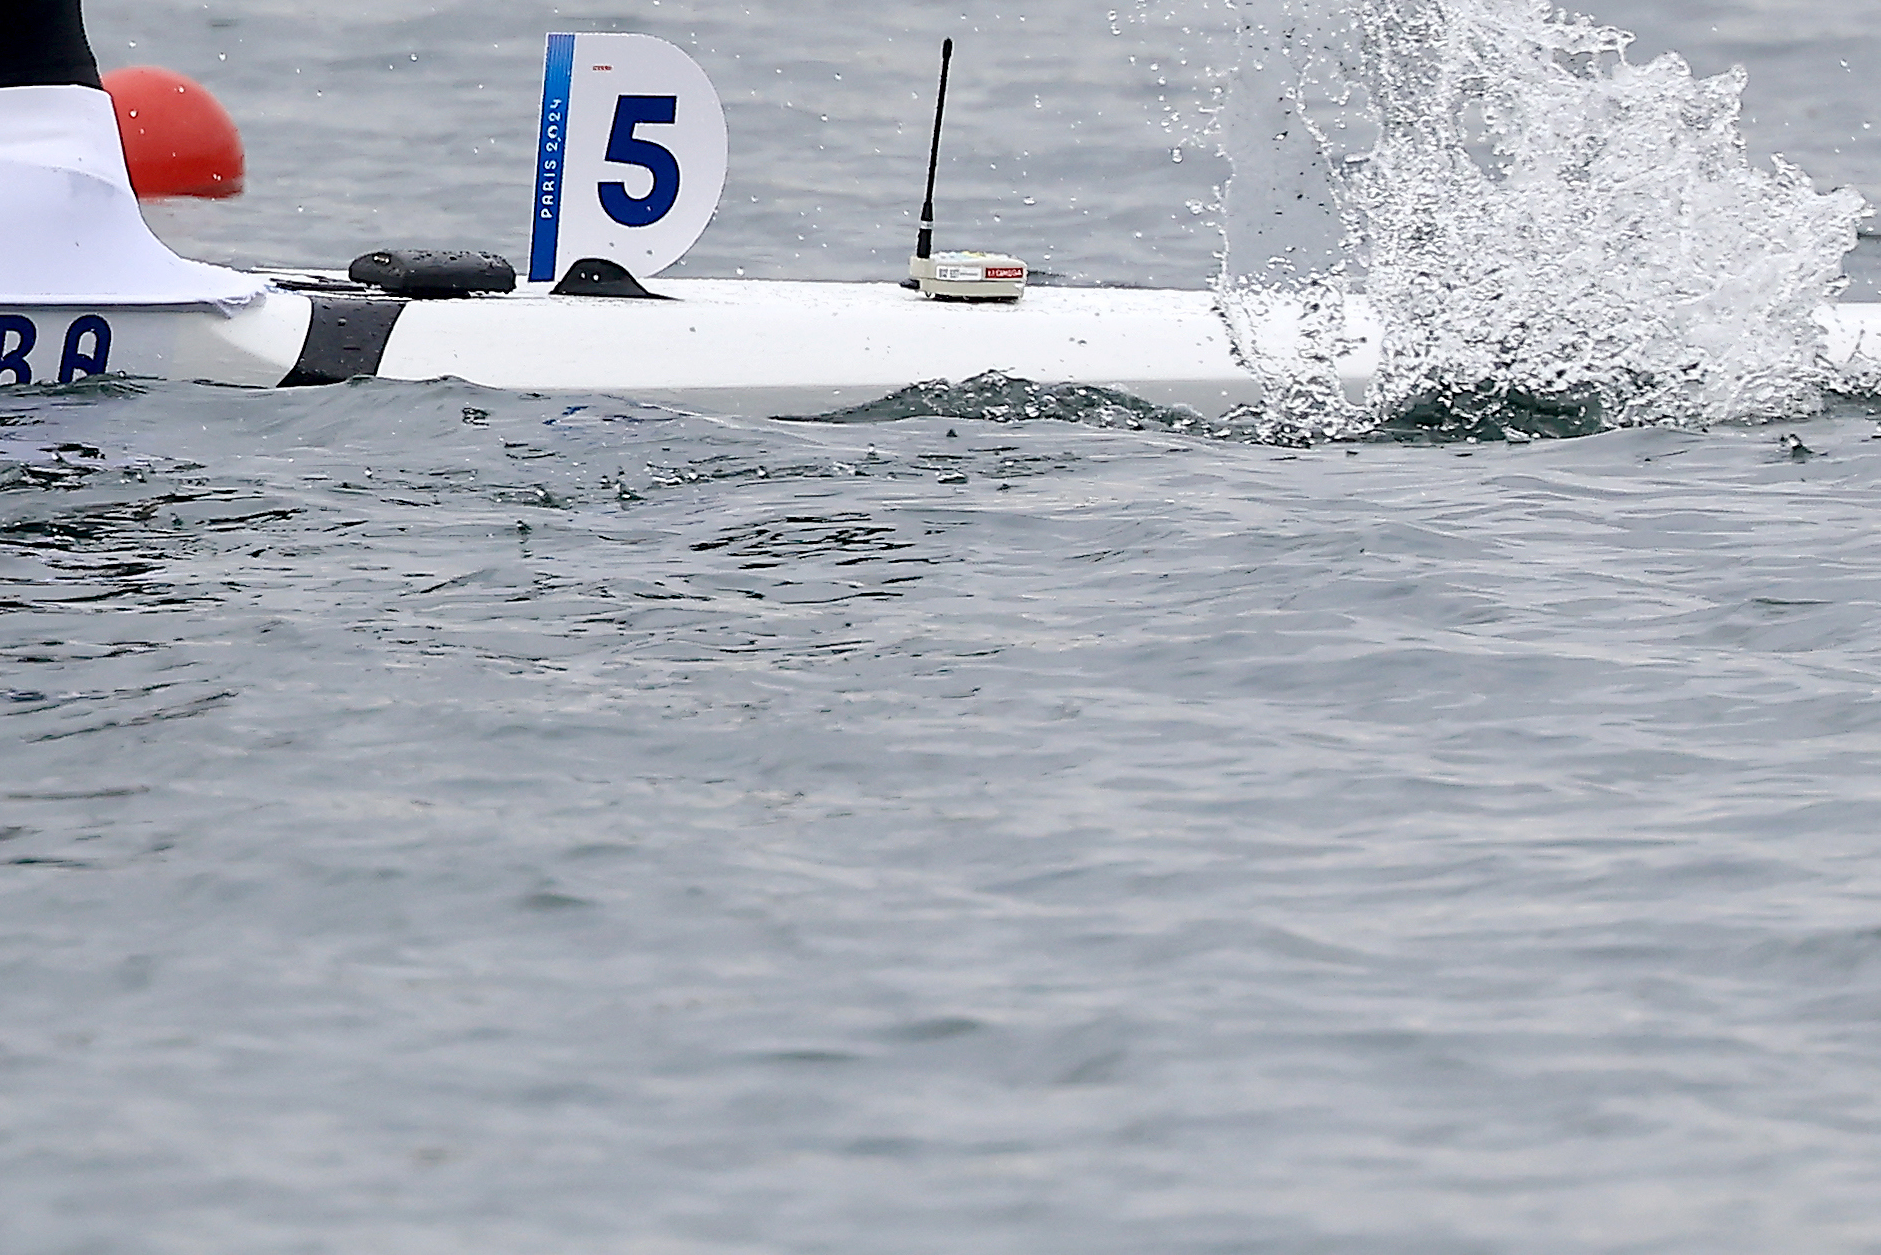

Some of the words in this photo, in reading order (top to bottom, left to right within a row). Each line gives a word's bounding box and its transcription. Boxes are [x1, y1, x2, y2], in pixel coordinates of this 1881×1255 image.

[545, 99, 562, 153] 2024
[540, 159, 557, 219] PARIS
[598, 95, 681, 228] 5
[57, 313, 113, 386] A
